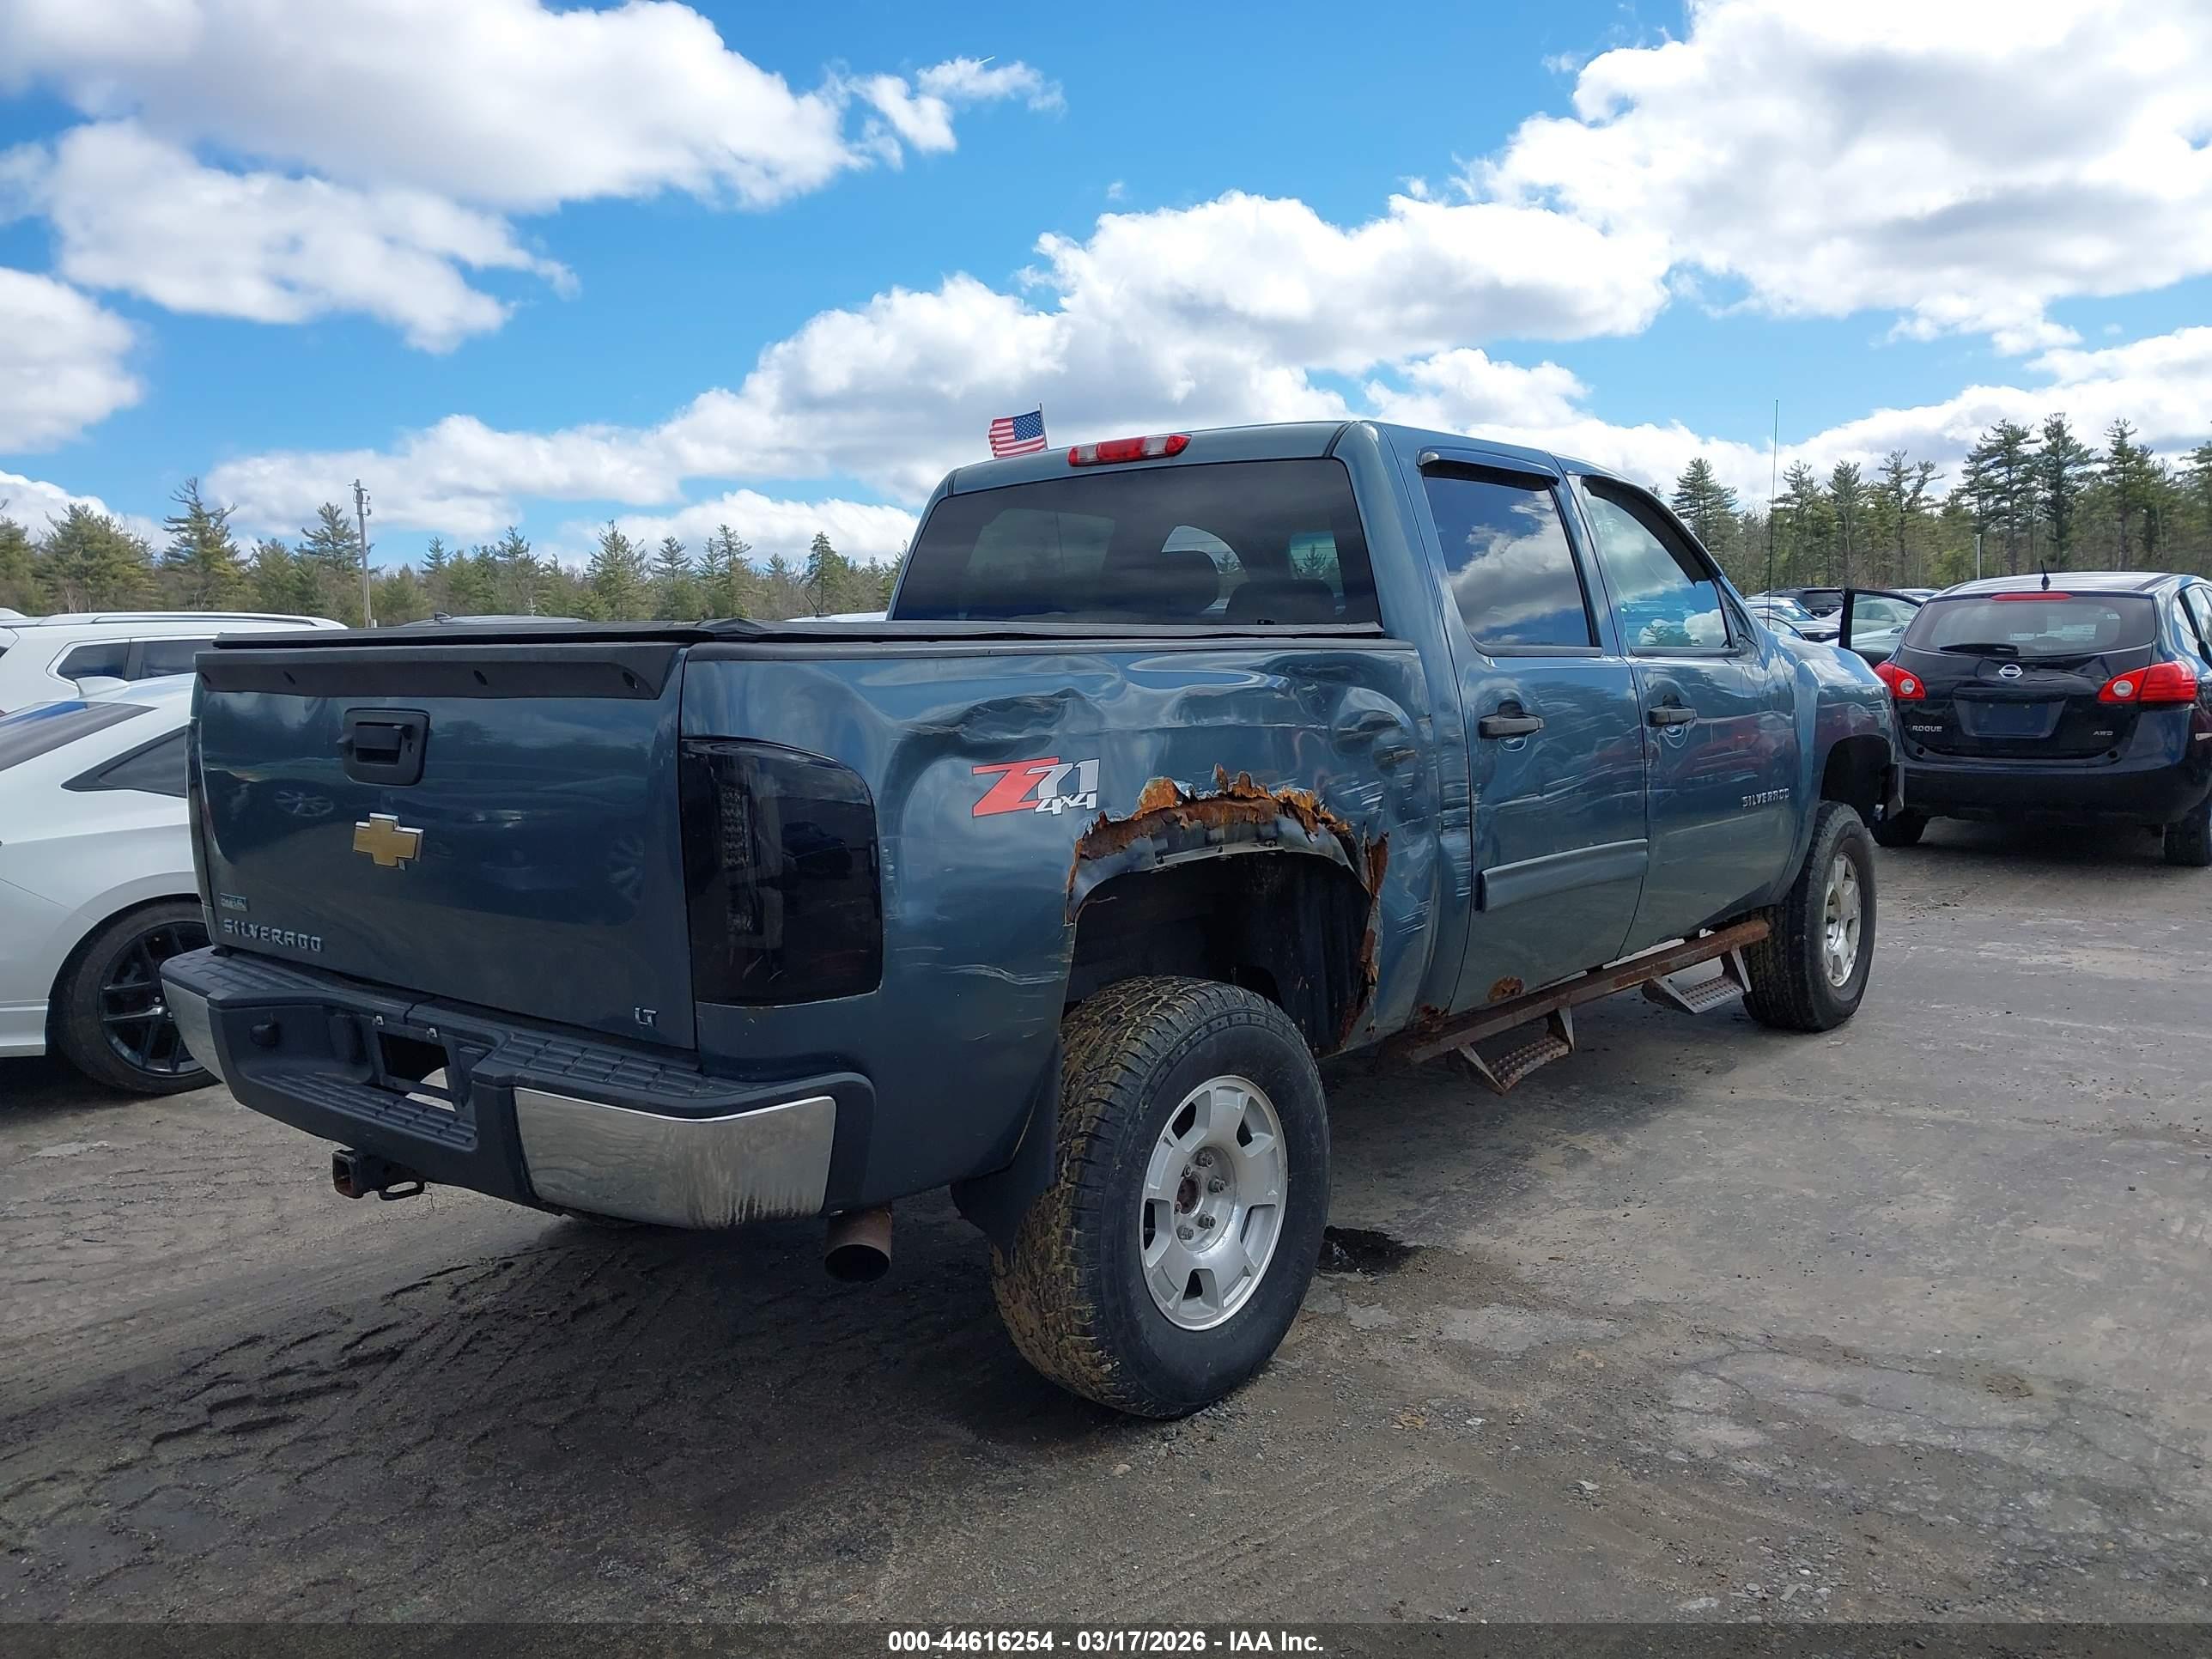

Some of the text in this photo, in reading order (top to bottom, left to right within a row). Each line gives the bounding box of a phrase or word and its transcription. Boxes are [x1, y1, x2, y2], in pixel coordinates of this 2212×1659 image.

[972, 756, 1101, 817] Z71
[1741, 787, 1790, 808] SILVERADO
[223, 918, 322, 952] SILVERADO
[635, 1007, 657, 1028] LT
